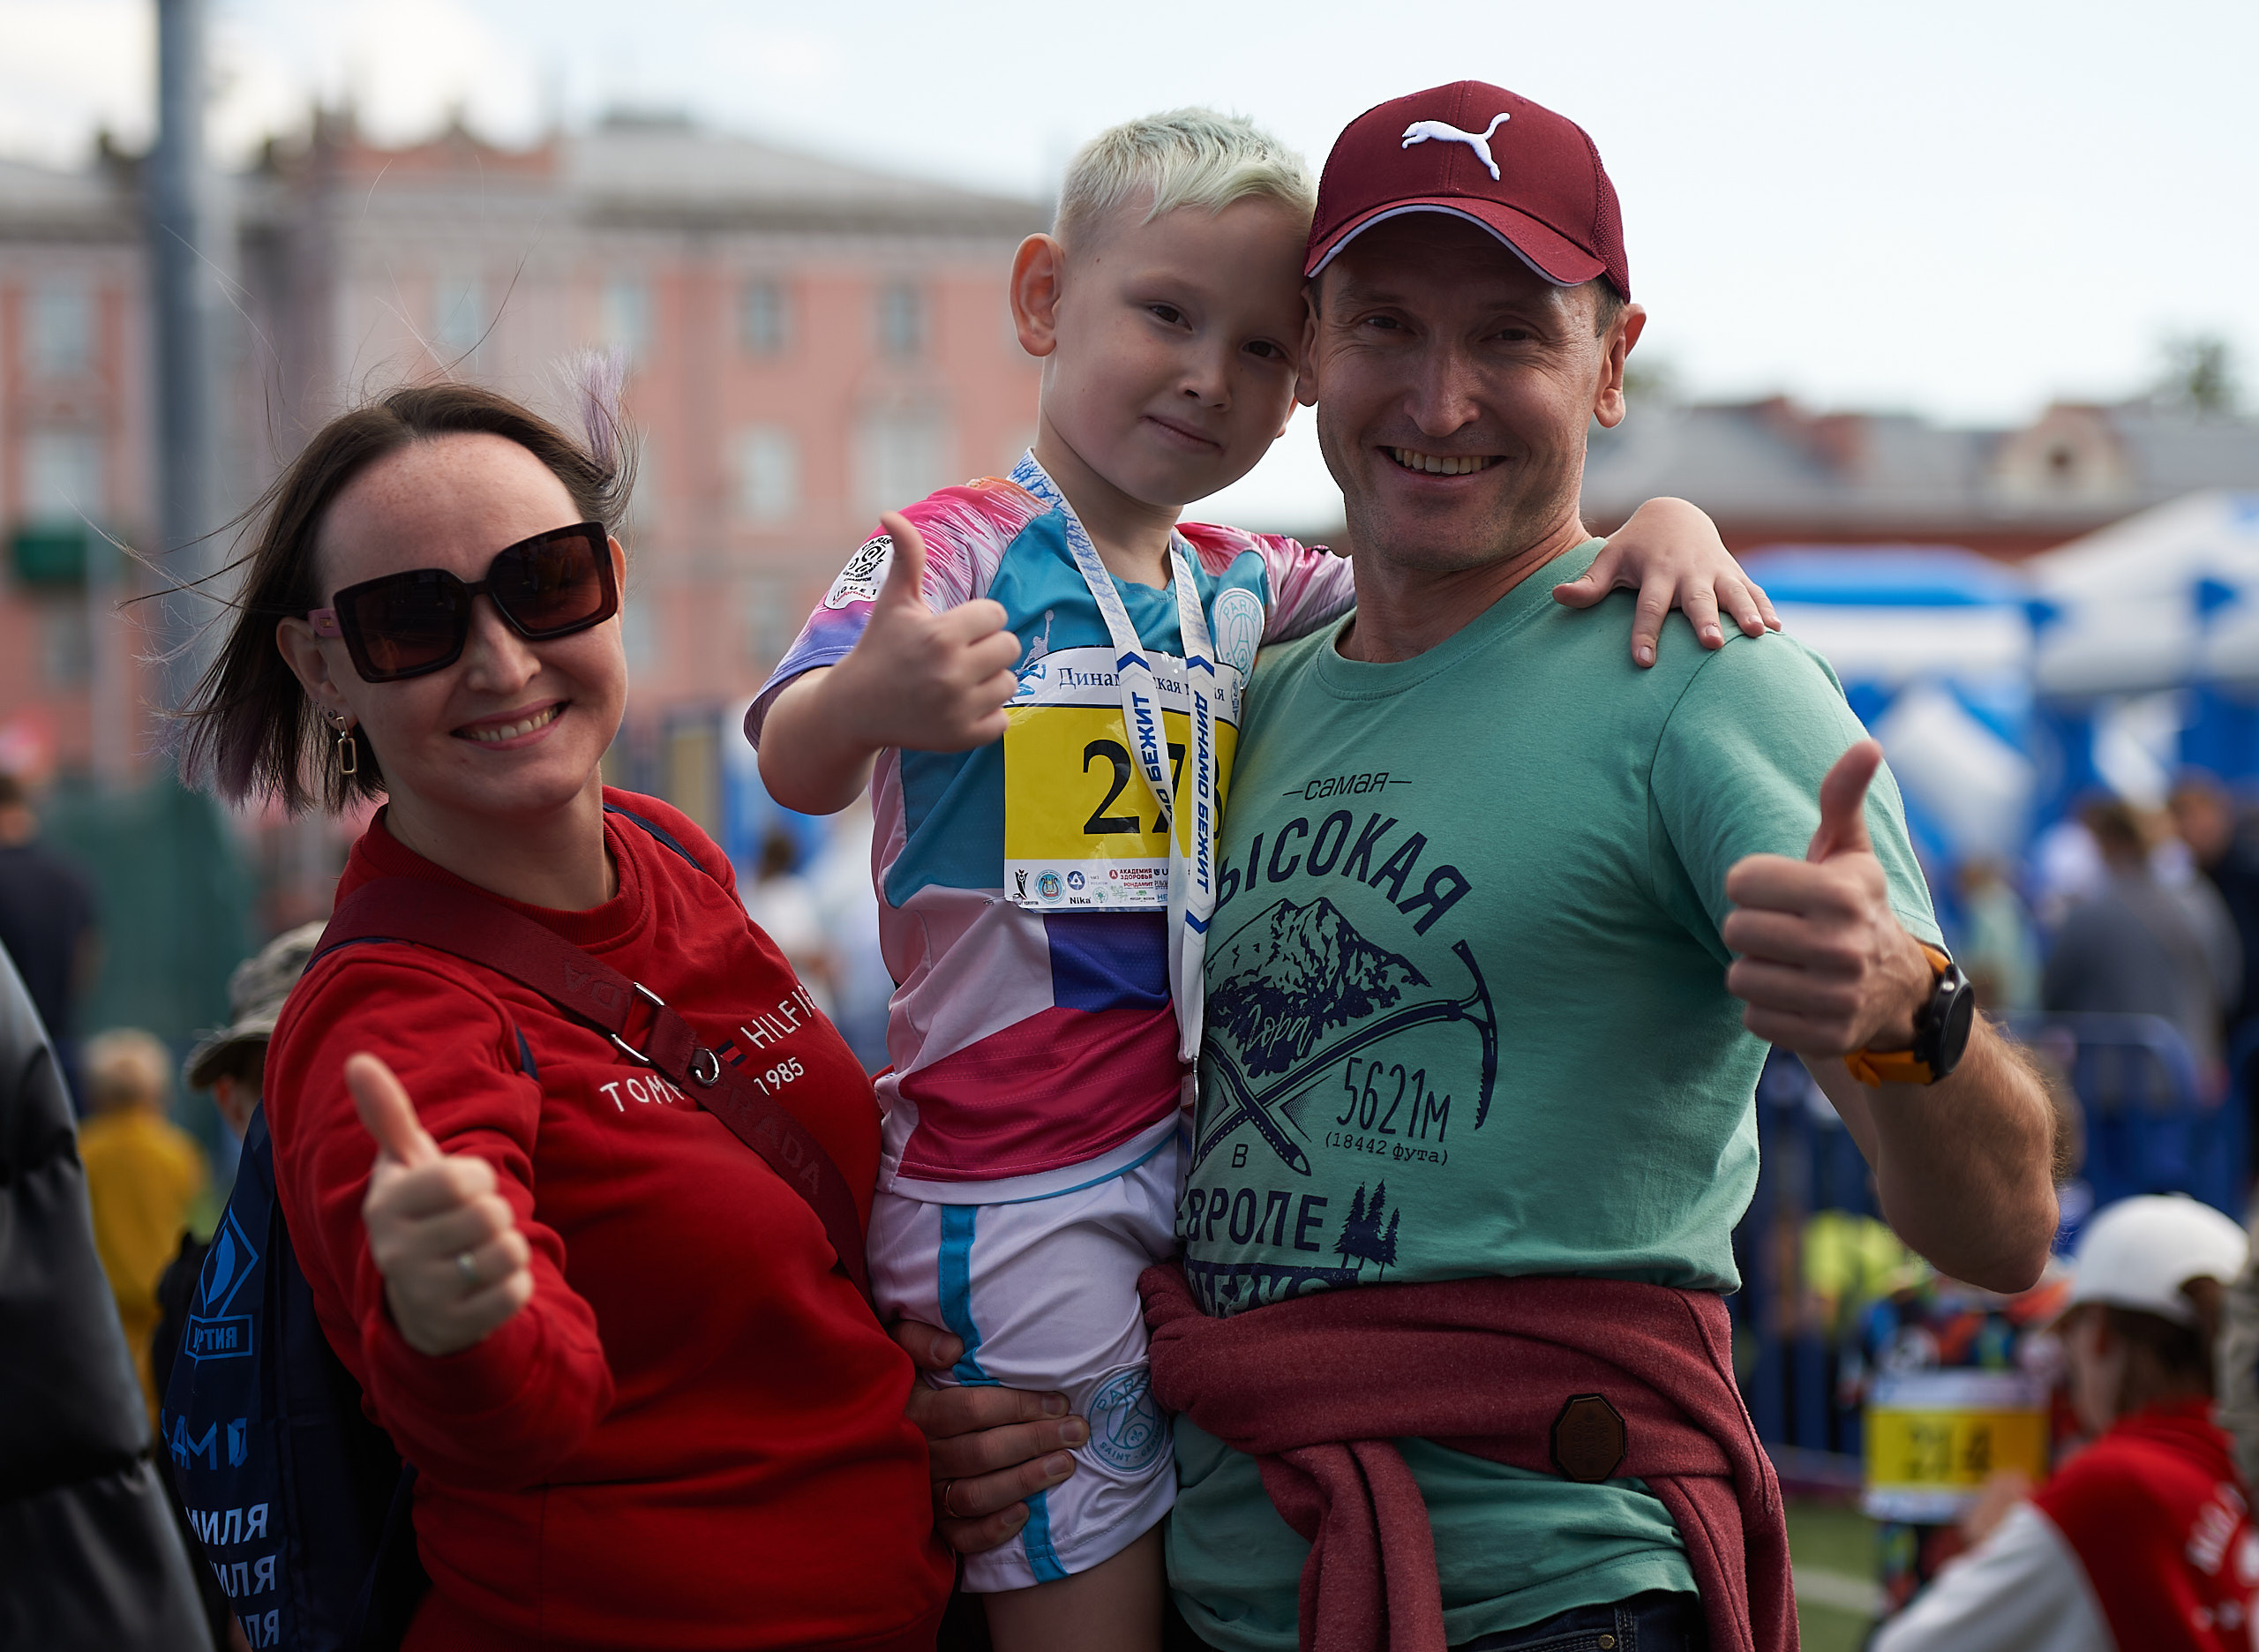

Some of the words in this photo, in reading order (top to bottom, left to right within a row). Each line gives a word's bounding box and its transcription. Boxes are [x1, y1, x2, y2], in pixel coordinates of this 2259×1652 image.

[1222, 598, 1259, 622] PARIS
[1131, 691, 1163, 782] БЕЖИТ
[1194, 689, 1209, 800] ДИНАМО
[1304, 772, 1390, 800] самая
[1197, 800, 1209, 894] БЕЖИТ
[1214, 809, 1473, 937] ЫСОКАЯ
[600, 1075, 685, 1112] TOM
[754, 1056, 804, 1095] 1985
[1325, 1131, 1388, 1155] (18442
[1392, 1144, 1449, 1166] фута)
[209, 1555, 276, 1598] ИЛЯ
